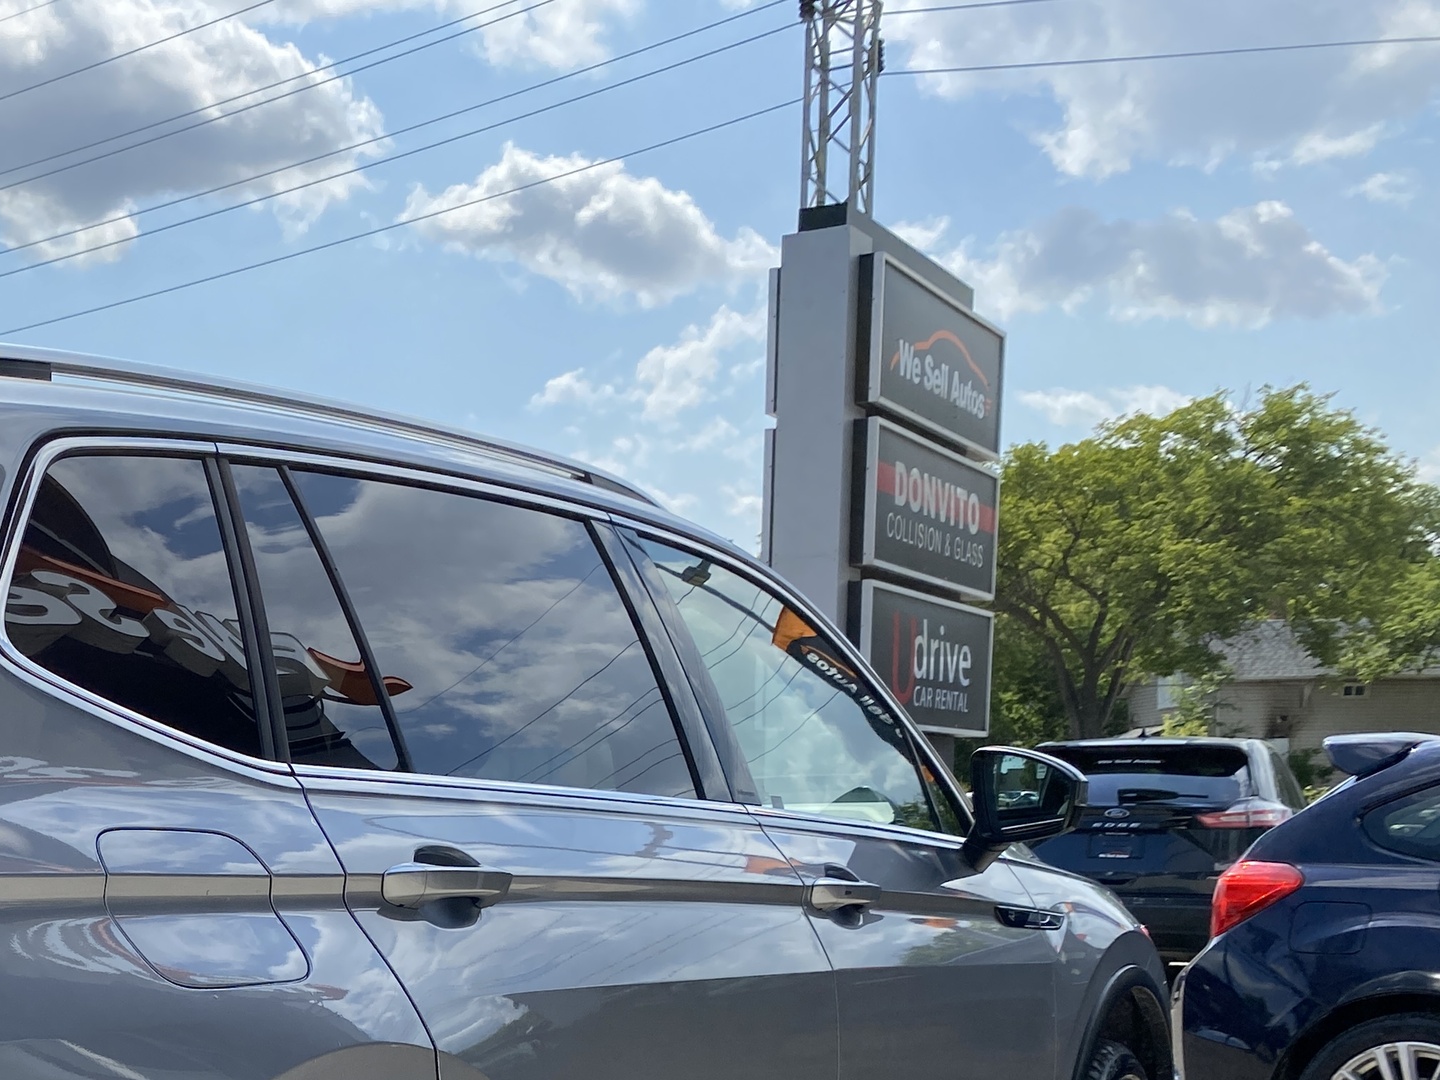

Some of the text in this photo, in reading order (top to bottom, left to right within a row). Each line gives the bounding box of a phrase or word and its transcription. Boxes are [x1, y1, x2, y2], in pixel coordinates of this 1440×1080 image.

[899, 338, 985, 419] We Sell Autos
[894, 460, 980, 535] DONVITO
[886, 511, 984, 568] COLLISION & GLASS
[913, 685, 969, 713] CAR RENTAL
